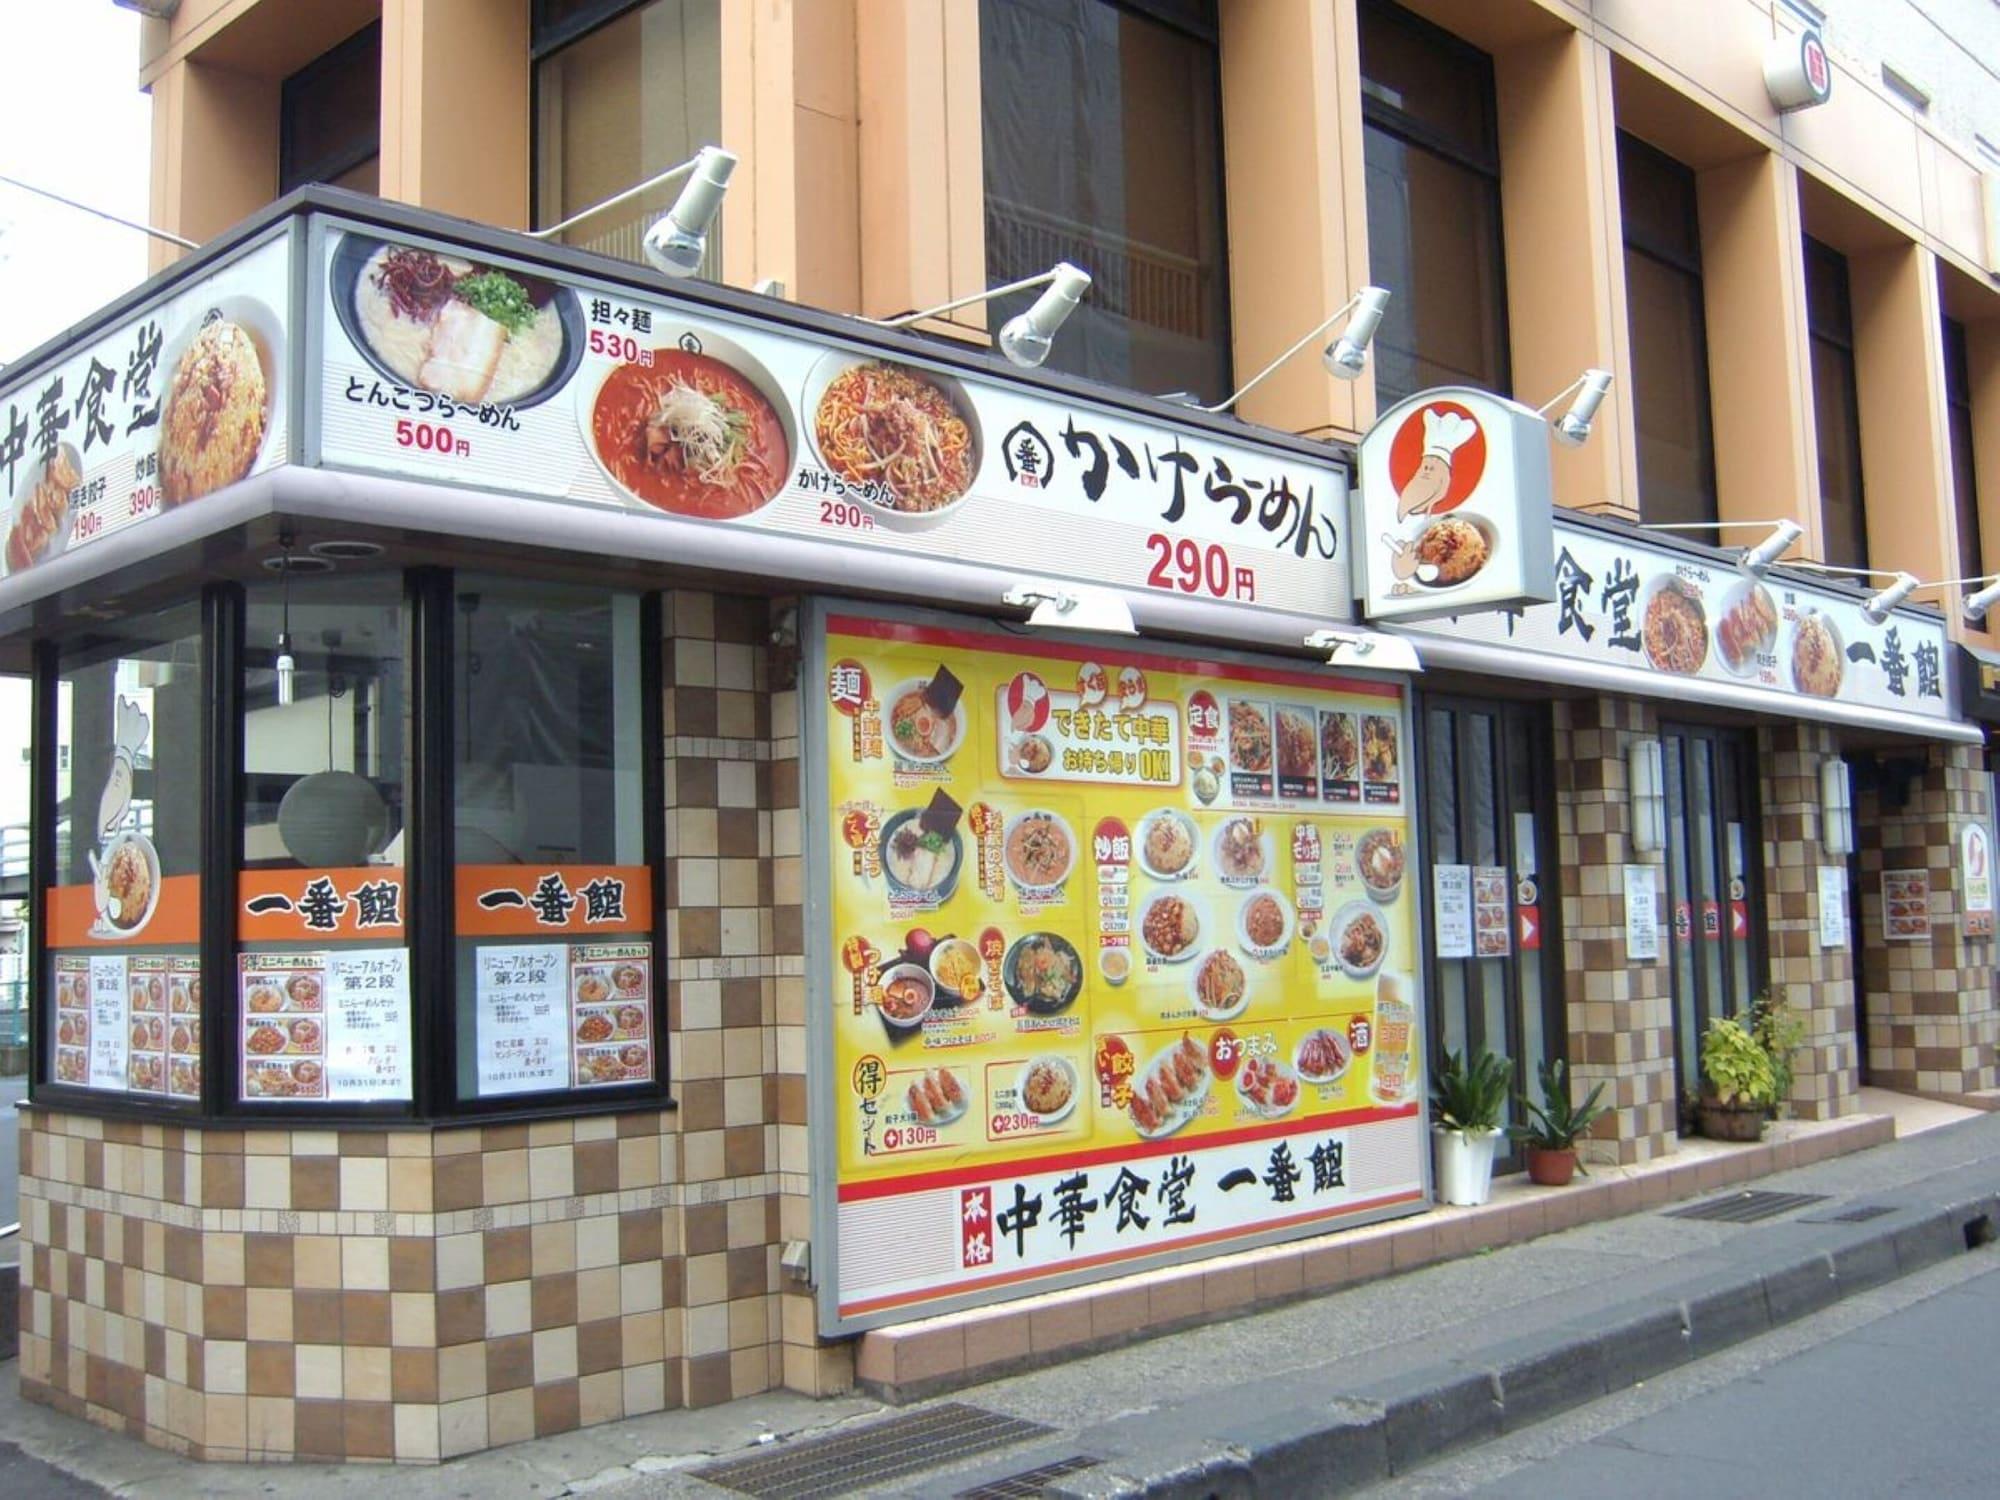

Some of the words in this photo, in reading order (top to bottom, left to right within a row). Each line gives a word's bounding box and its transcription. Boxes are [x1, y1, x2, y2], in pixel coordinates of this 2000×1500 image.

[590, 298, 653, 335] 担々麺
[589, 328, 654, 369] 530円
[0, 320, 164, 497] 中華食堂
[395, 419, 470, 458] 500円
[1059, 413, 1337, 560] かけらーめん
[73, 511, 103, 541] 190円
[819, 500, 875, 531] 290円
[1146, 532, 1256, 603] 290円
[831, 665, 862, 706] 麺
[1846, 625, 1942, 699] 一番館
[1050, 708, 1172, 746] できたて中華
[1188, 704, 1220, 730] 定食
[1094, 835, 1130, 861] 炒飯
[245, 875, 401, 930] 一番館
[478, 872, 627, 925] 一番館
[1215, 1030, 1278, 1062] おつまみ
[1111, 1051, 1135, 1110] 餃子
[1216, 1138, 1346, 1203] 一番館
[963, 1190, 992, 1265] 本格
[996, 1153, 1197, 1259] 中華食堂
